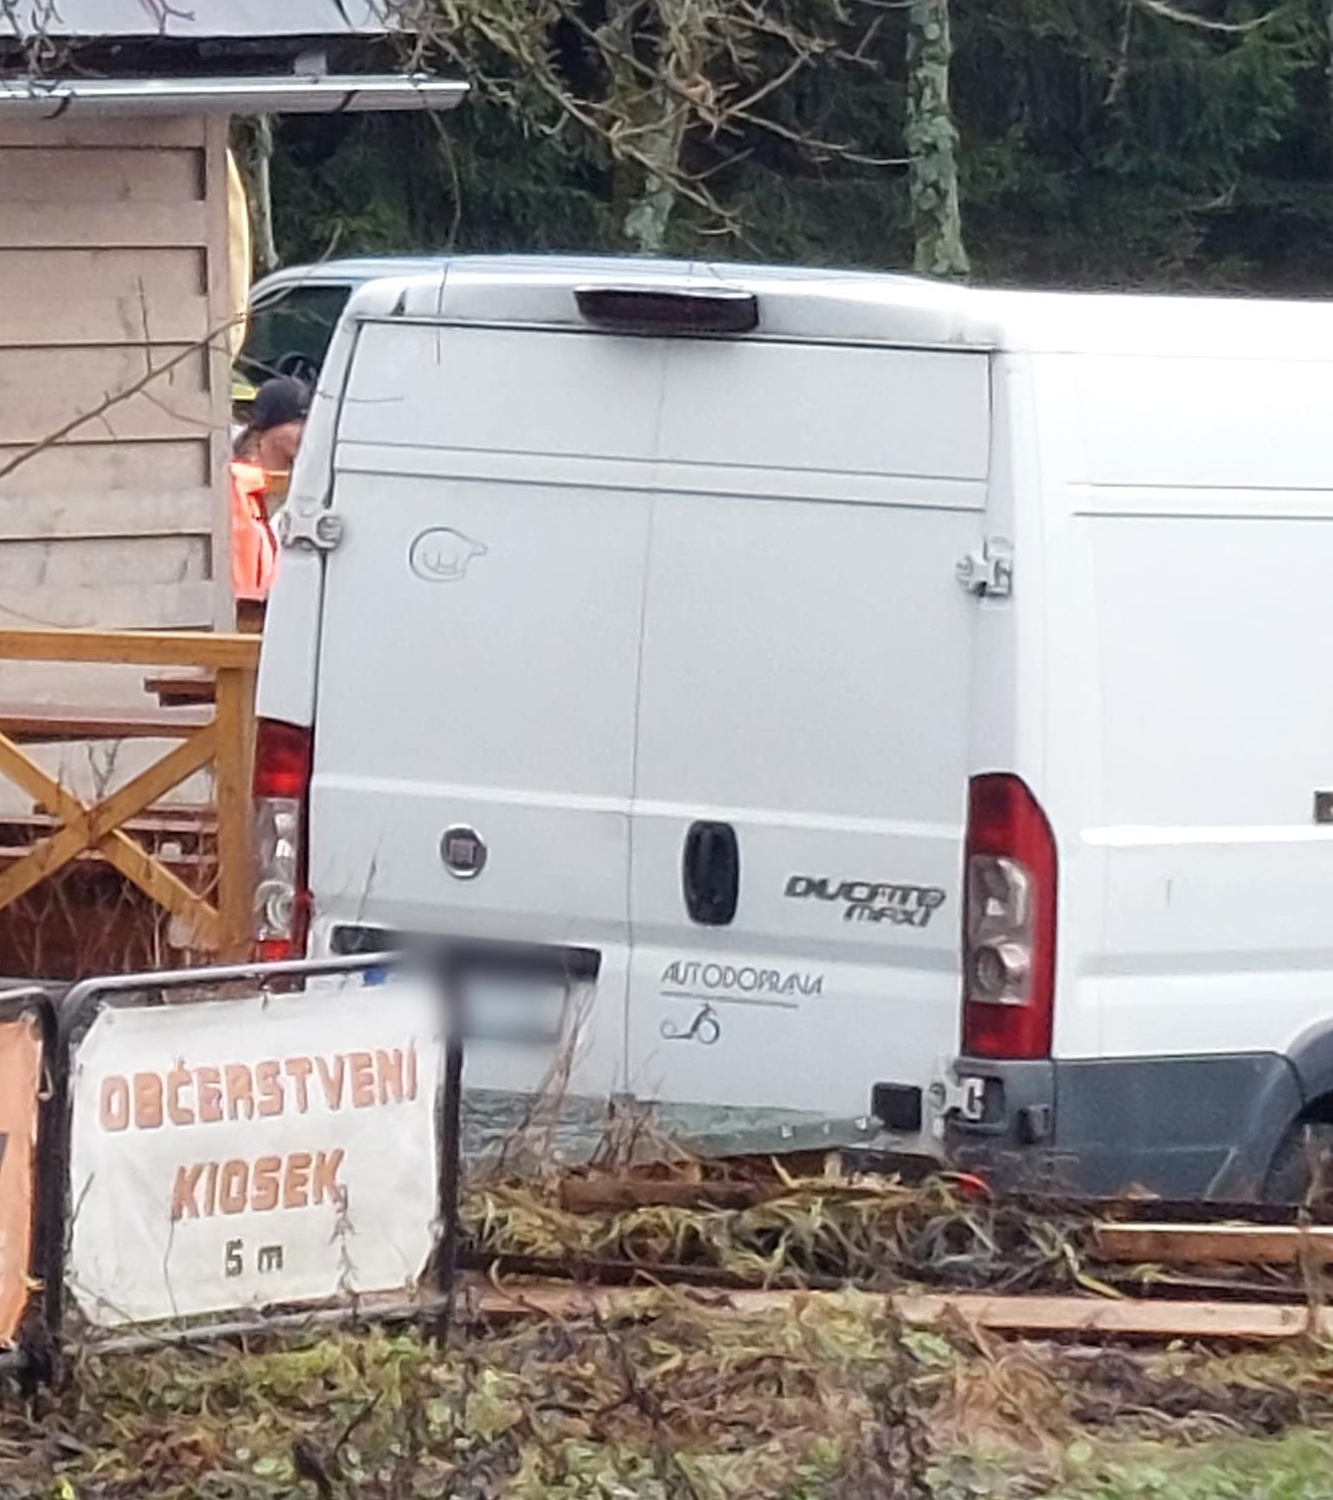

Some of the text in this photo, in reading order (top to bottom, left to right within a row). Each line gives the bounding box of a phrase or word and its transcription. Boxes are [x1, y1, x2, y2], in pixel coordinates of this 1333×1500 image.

[784, 875, 947, 909] DUCATO
[660, 961, 824, 997] AUTODOPRAVA
[99, 1040, 418, 1133] OBČERSTVENÍ
[170, 1148, 345, 1222] KIOSEK
[225, 1238, 284, 1277] 5 m
